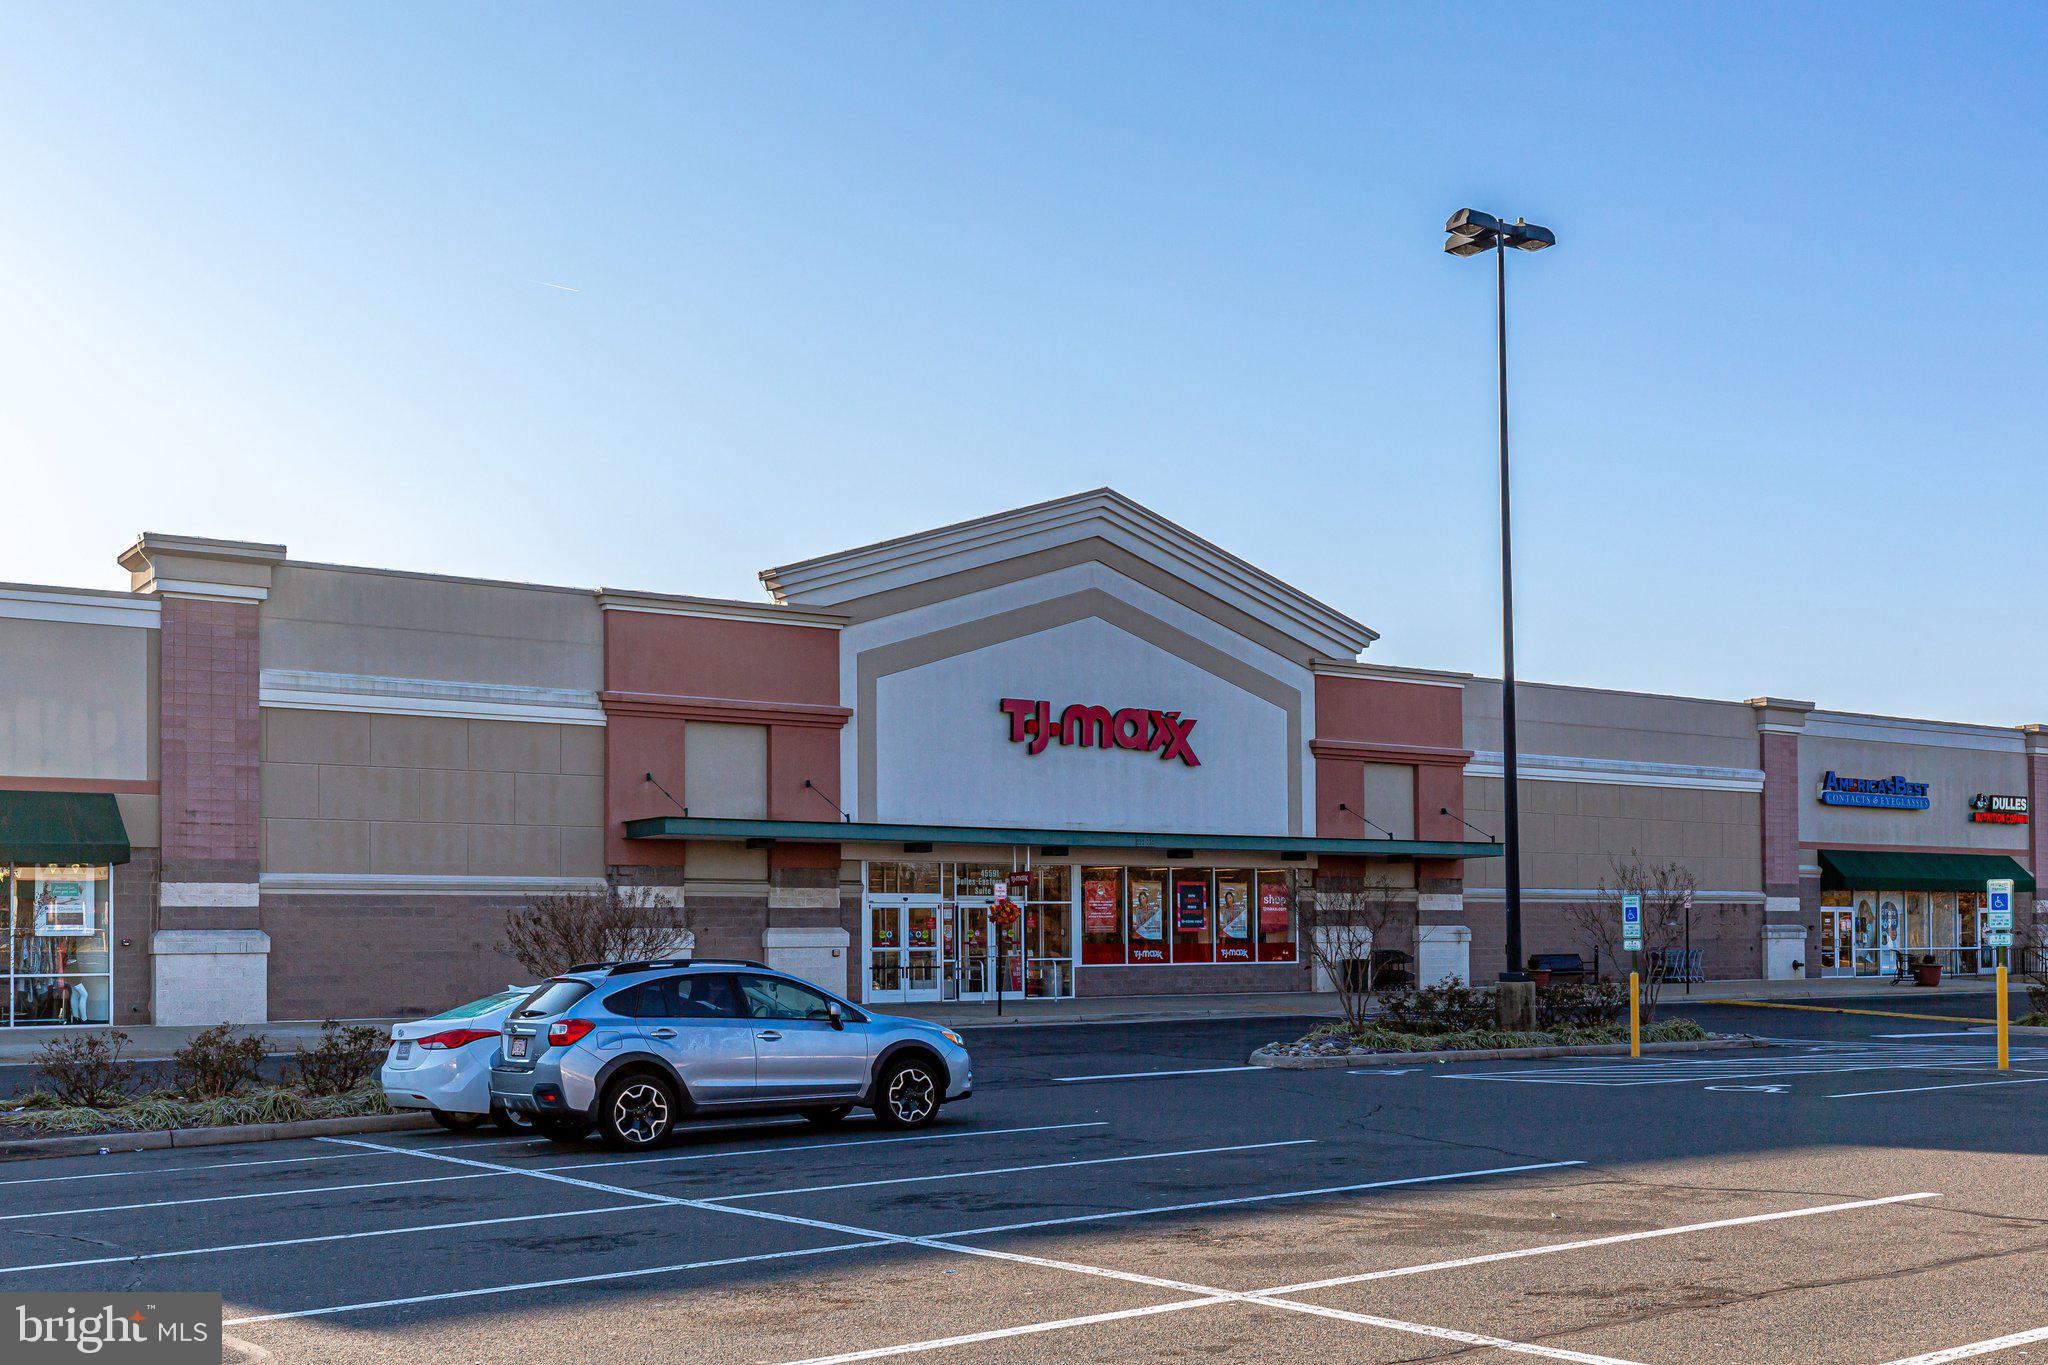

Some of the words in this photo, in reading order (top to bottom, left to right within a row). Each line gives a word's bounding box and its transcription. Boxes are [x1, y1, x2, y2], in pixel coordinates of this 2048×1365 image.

[1826, 793, 1871, 803] CONTACTS
[1880, 795, 1928, 807] EYEGLASSES
[1992, 797, 2027, 811] DULLES
[980, 869, 1000, 878] 45591
[974, 886, 992, 895] Suite
[1263, 894, 1287, 906] shop
